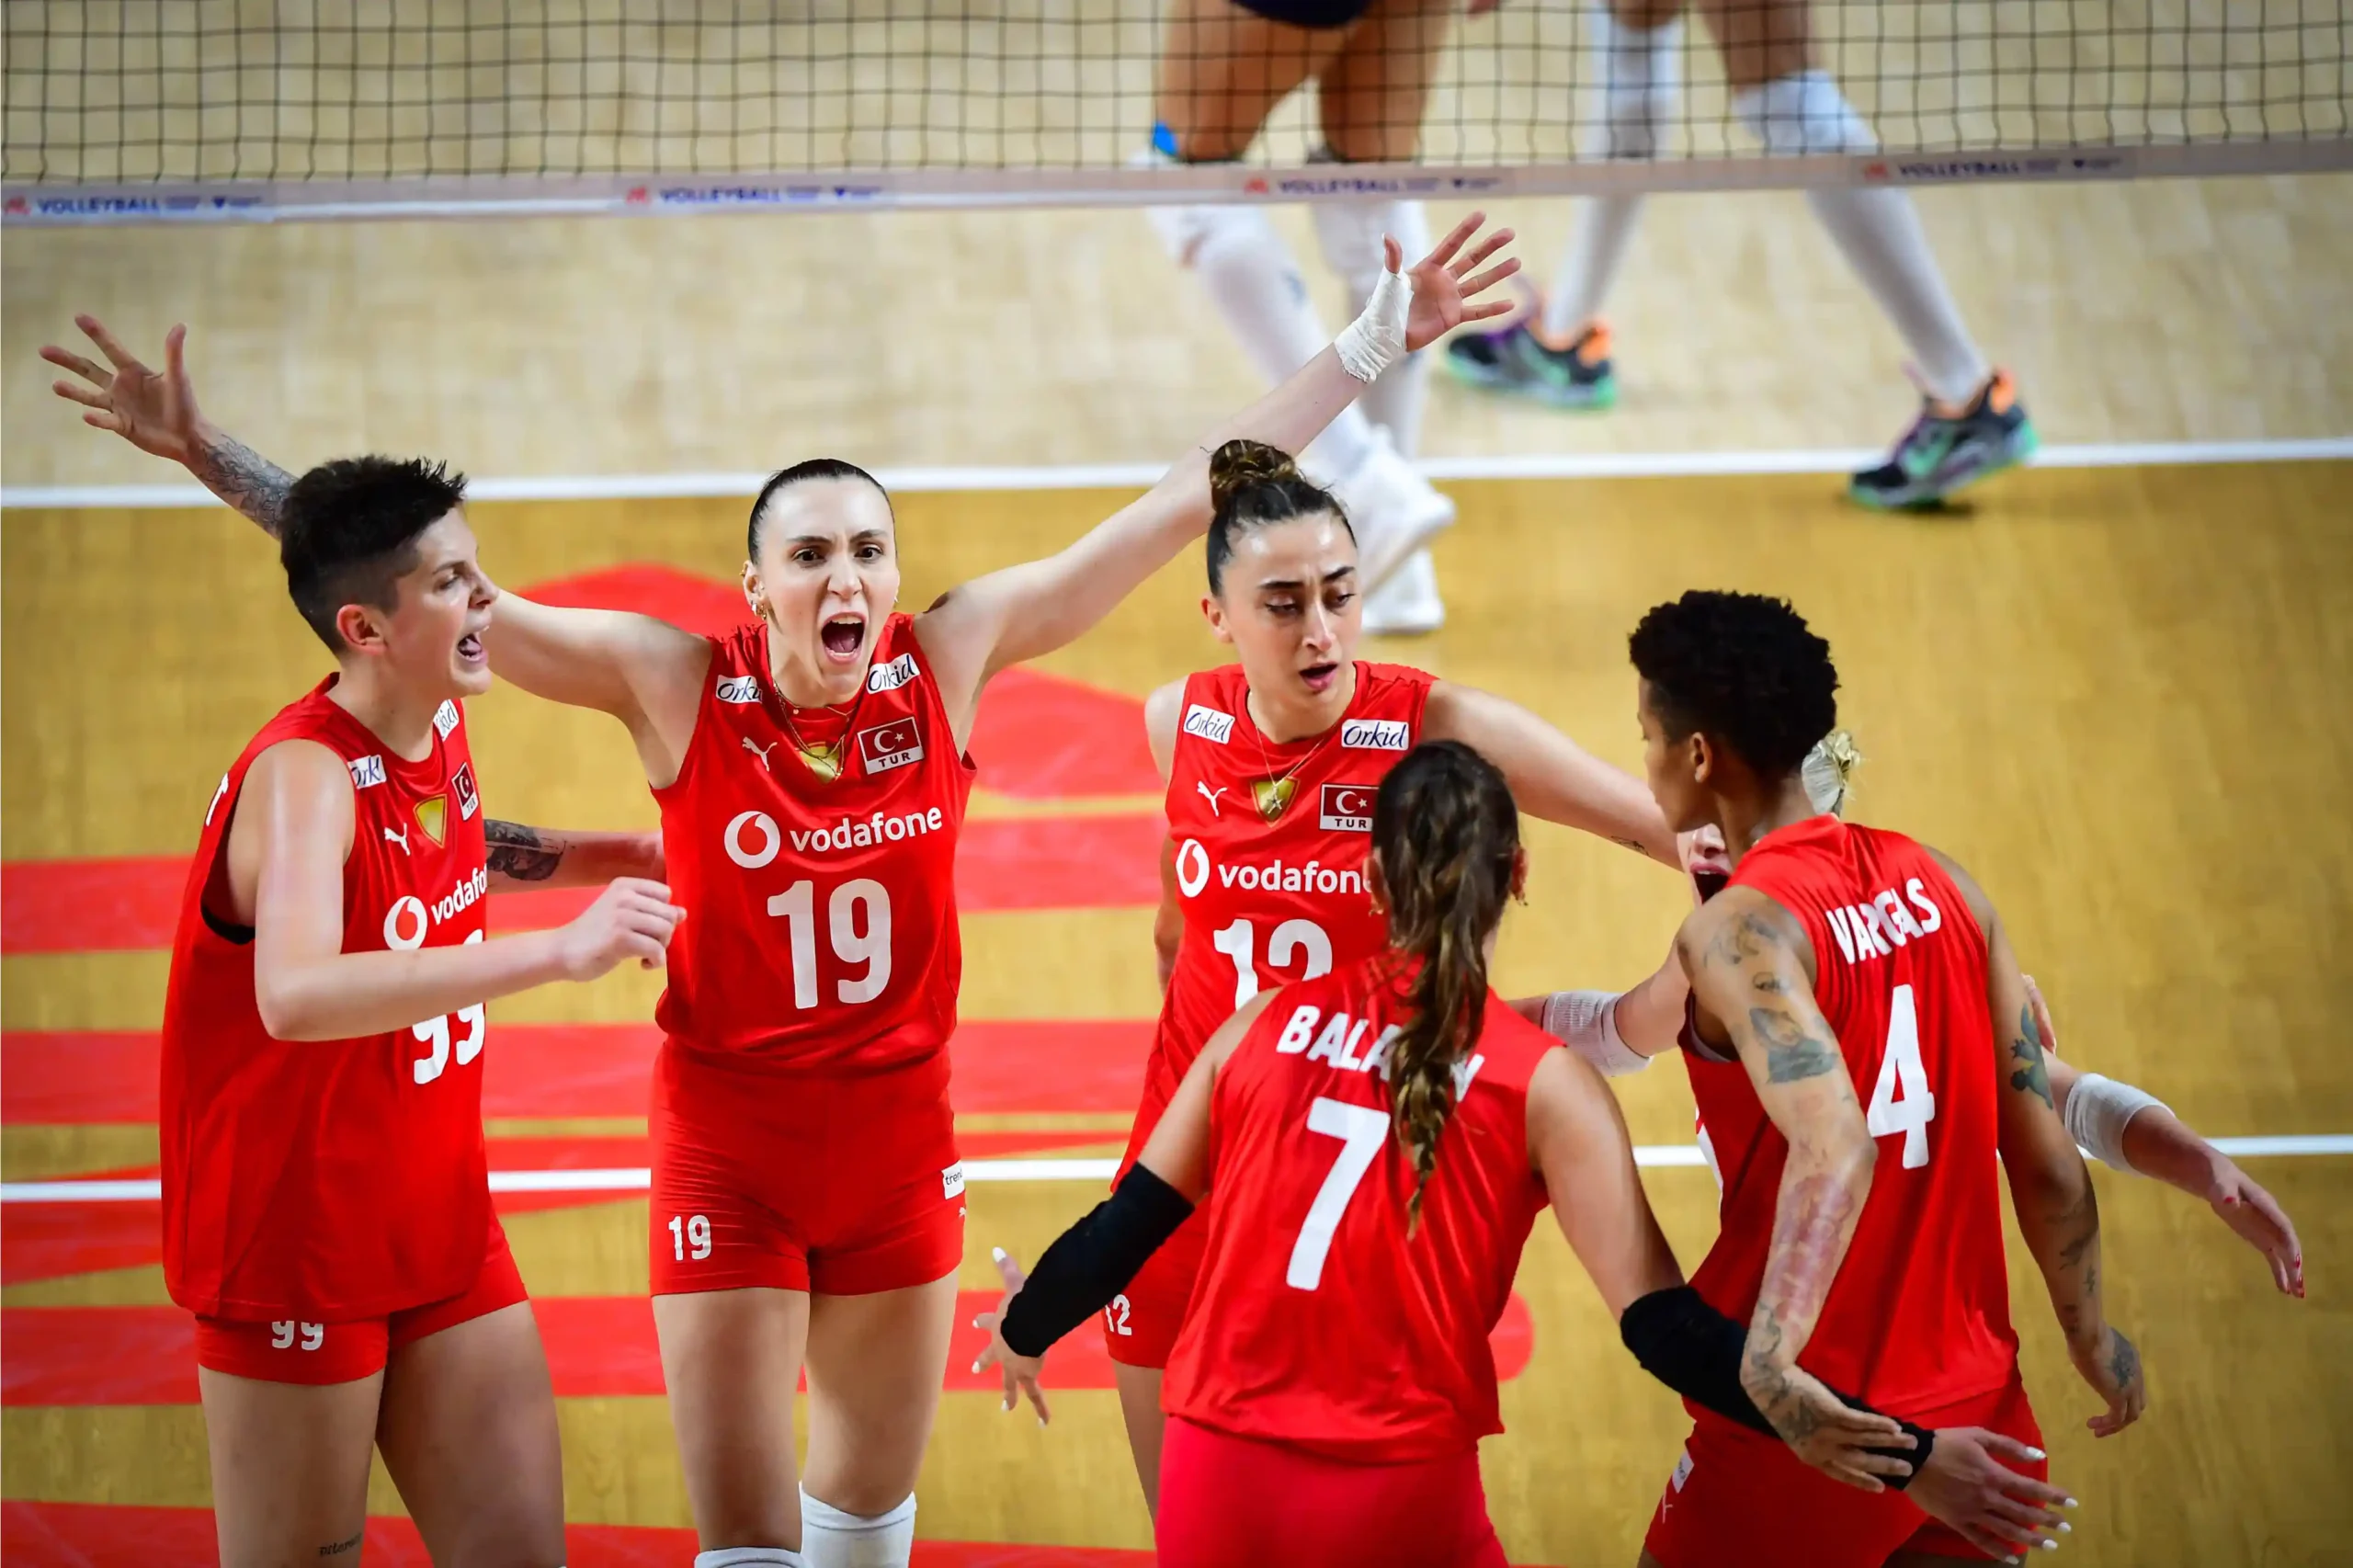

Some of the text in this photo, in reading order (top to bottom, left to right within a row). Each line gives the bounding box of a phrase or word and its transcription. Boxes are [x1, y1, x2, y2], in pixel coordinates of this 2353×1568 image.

[1279, 176, 1399, 194] VOLLEYBALL
[1898, 160, 2019, 176] VOLLEYBALL
[37, 195, 160, 214] VOLLEYBALL
[659, 187, 780, 203] VOLLEYBALL
[867, 653, 915, 691] Orkid
[1186, 711, 1232, 741] Orkid
[1343, 722, 1406, 748] Orkid
[879, 752, 911, 768] TUR
[790, 807, 942, 853] vodafone
[1335, 818, 1367, 828] TUR
[431, 863, 487, 926] vodafo
[1825, 877, 1941, 964] VARGAS
[767, 878, 892, 1009] 19
[1867, 983, 1935, 1169] 4
[1286, 1096, 1391, 1290] 7
[668, 1215, 711, 1260] 19
[1105, 1294, 1132, 1335] 12
